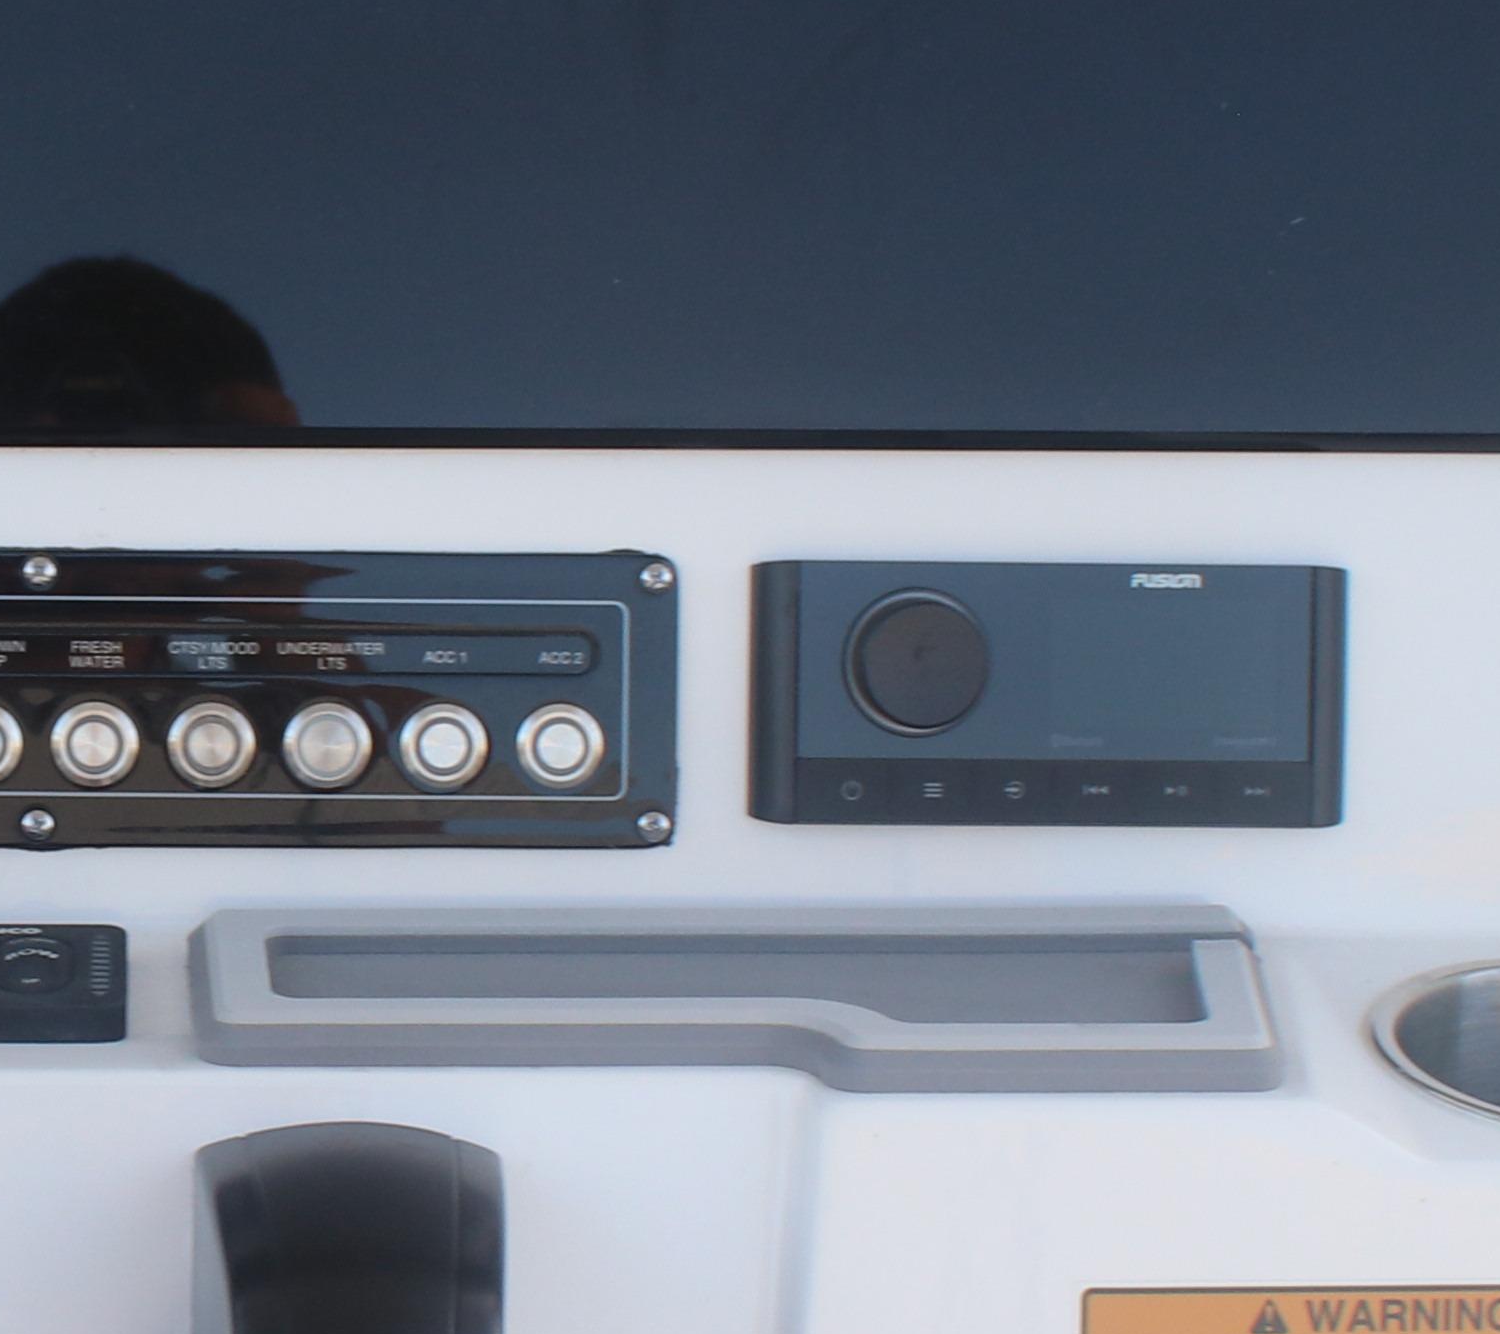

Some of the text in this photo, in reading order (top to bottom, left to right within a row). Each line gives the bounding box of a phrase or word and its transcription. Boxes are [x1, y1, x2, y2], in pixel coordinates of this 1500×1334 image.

[1130, 573, 1204, 588] FUSION
[69, 641, 122, 654] FRESH
[276, 642, 386, 655] UNDERWATER
[68, 656, 125, 668] WATER
[198, 657, 228, 670] LTS
[317, 657, 347, 670] LTS
[423, 651, 468, 664] ACC 1
[537, 652, 585, 665] ACC 2
